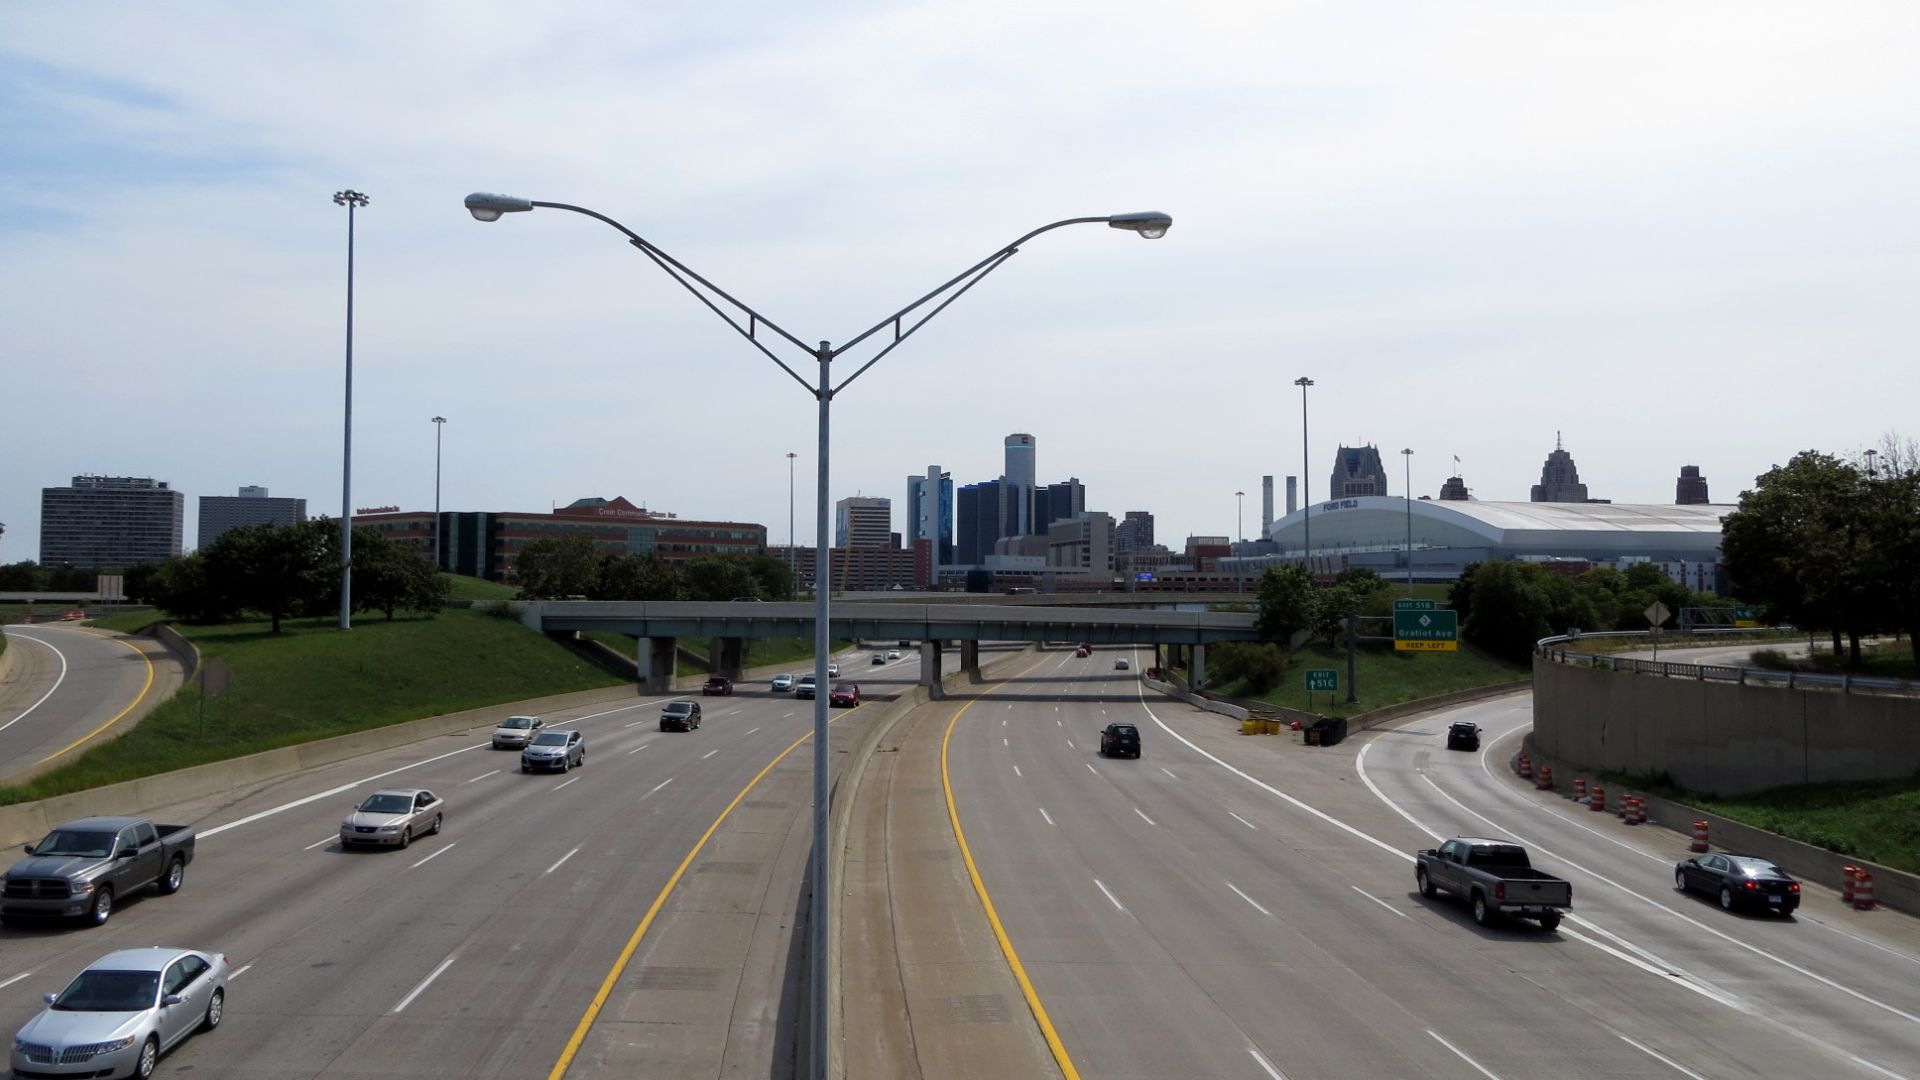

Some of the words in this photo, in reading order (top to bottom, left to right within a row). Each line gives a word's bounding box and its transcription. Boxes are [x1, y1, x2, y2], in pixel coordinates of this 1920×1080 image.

[1323, 501, 1339, 512] FORD
[1340, 499, 1358, 509] FIELD
[599, 508, 616, 516] Crain
[617, 509, 666, 518] Communtions
[1399, 630, 1433, 638] Gratiot
[1435, 630, 1453, 638] Ave
[1317, 679, 1334, 688] 51C
